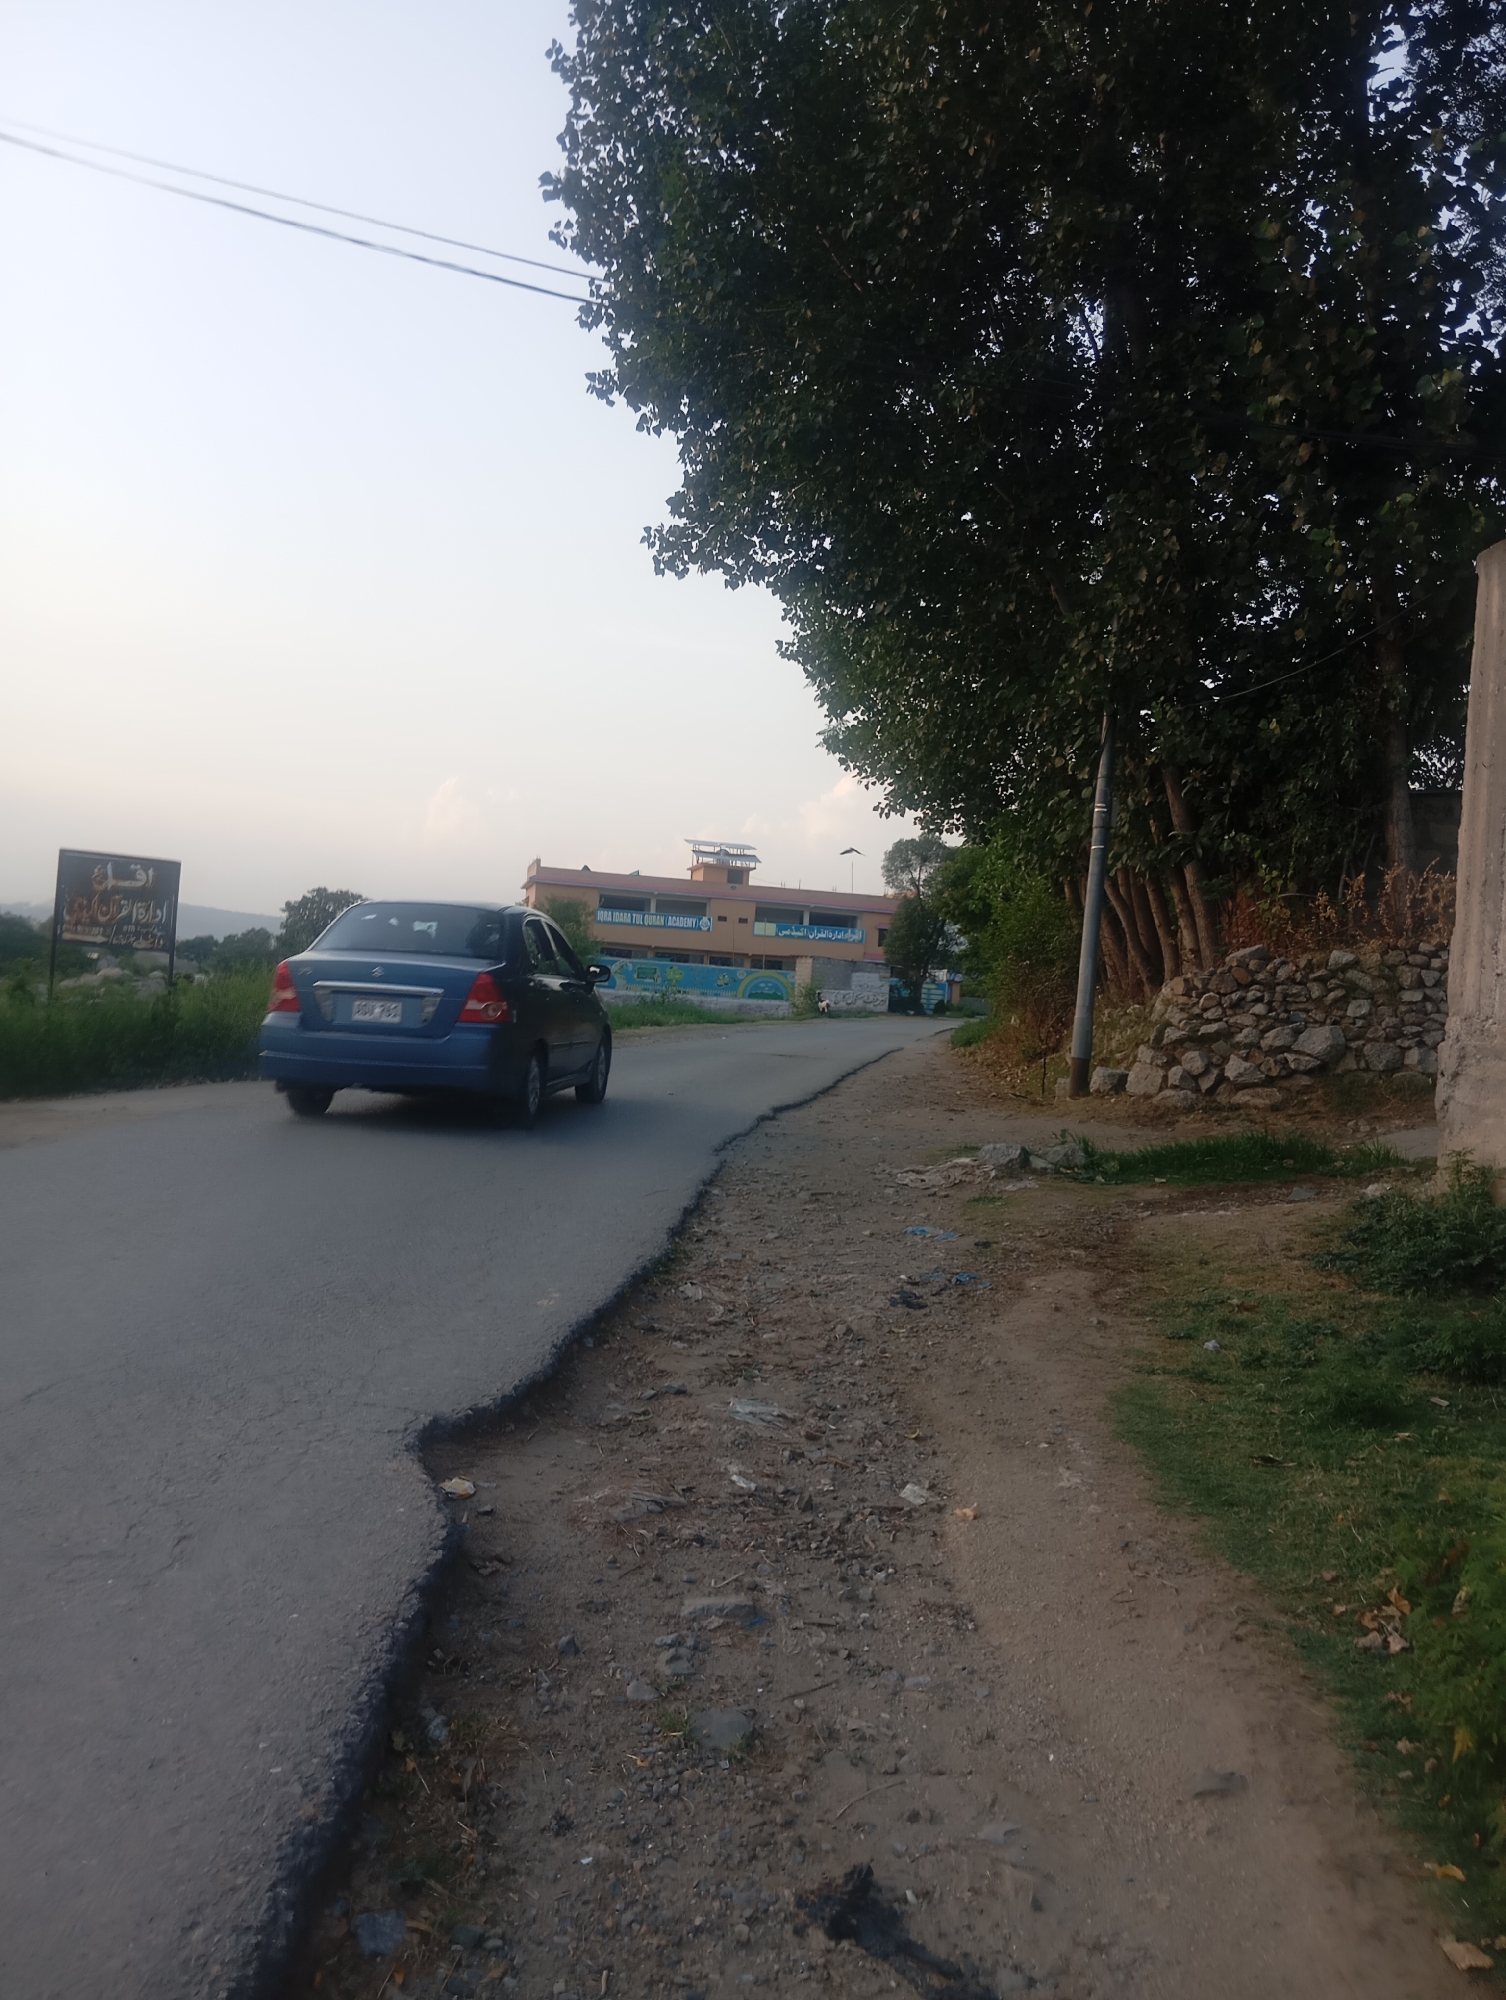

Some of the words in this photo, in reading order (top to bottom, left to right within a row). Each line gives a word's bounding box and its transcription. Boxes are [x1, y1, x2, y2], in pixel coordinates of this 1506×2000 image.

[597, 910, 612, 923] IQRA
[613, 912, 631, 924] IDARA
[632, 913, 643, 925] TUL
[644, 914, 665, 926] QURAN
[665, 915, 699, 929] (ACADEMY)
